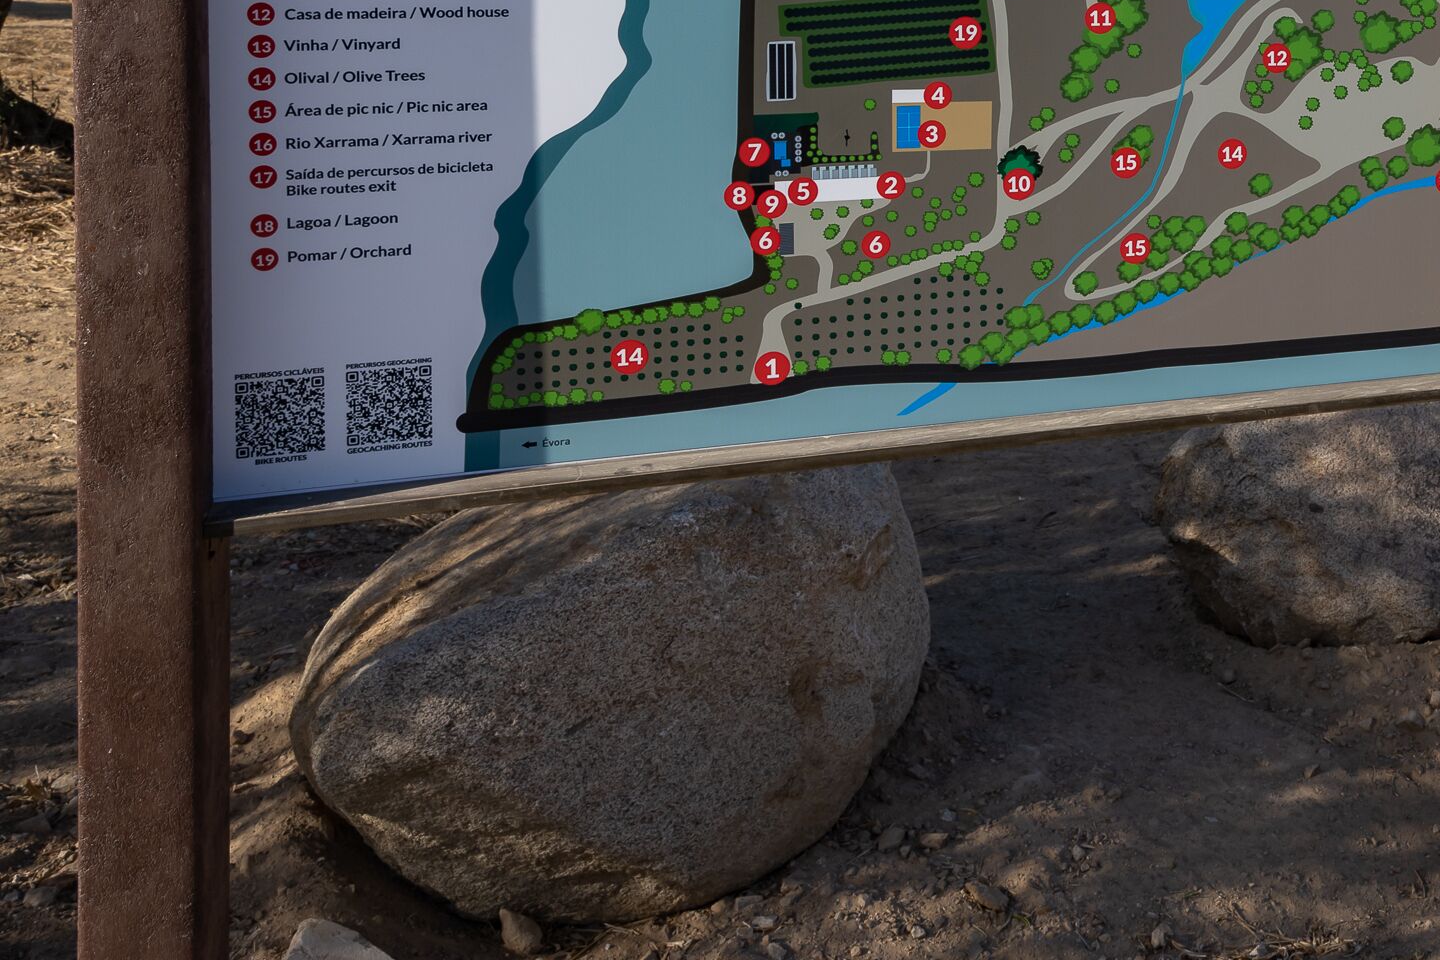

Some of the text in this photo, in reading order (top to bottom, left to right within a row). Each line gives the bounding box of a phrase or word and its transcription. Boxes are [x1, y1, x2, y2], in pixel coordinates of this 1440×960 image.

[252, 6, 509, 21] 12 Casa de madeira / Wood house
[1090, 10, 1112, 26] 11
[954, 24, 978, 41] 19
[252, 38, 400, 53] 13 Vinha / Vinyard
[1267, 50, 1287, 66] 12
[253, 70, 426, 86] 14 Olival / Olive Trees
[931, 86, 945, 104] 4
[254, 100, 488, 119] 15 Área de pic nic / Pic nic area
[252, 131, 492, 153] 16 Rio Xarrama / Xarrama river
[926, 125, 938, 142] 3
[748, 143, 762, 162] 7
[1222, 146, 1243, 162] 14
[1116, 154, 1137, 171] 15
[254, 162, 493, 184] 17 Saída de percursos de bicicleta
[286, 180, 396, 196] Bike routes exit
[797, 182, 810, 200] 5
[884, 176, 898, 194] 2
[1008, 176, 1030, 192] 10
[732, 187, 746, 205] 8
[765, 195, 779, 213] 9
[255, 214, 398, 233] 18 Lagoa / Lagoon
[759, 232, 772, 250] 6
[869, 236, 883, 254] 6
[1125, 240, 1146, 256] 15
[256, 244, 412, 266] 19 Pomar / Orchard
[346, 357, 432, 370] PERCURSOS GEOCACHING
[616, 348, 643, 366] 14
[234, 367, 325, 381] PERCURSOS CICLÁVEIS
[765, 358, 780, 379] 1
[346, 440, 433, 454] GEOCACHING ROUTES
[542, 437, 571, 448] Évora
[255, 454, 307, 466] BIKE ROUTES
